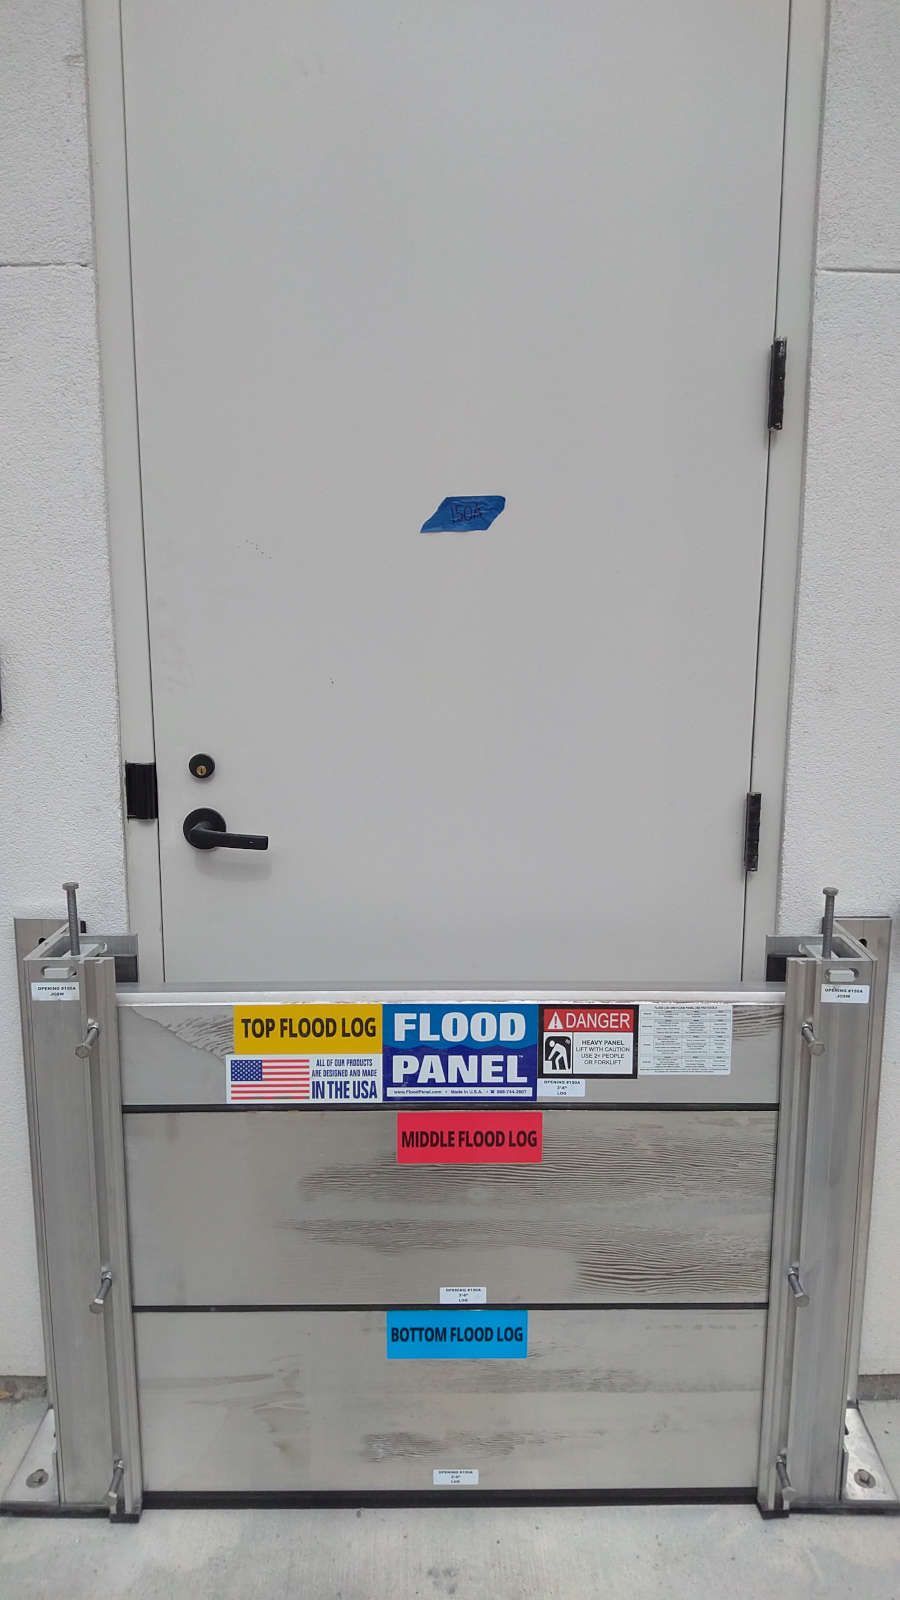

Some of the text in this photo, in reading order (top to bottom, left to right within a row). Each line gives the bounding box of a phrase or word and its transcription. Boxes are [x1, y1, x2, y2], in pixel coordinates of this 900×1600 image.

[241, 1017, 376, 1038] TOP FLOOD LOG
[394, 1012, 526, 1042] FLOOD
[566, 1012, 631, 1029] DANGER
[316, 1059, 372, 1067] ALL OF OUR PRODUCTS
[323, 1069, 348, 1077] DESIGNED
[350, 1069, 360, 1077] AND
[362, 1069, 377, 1077] MADE
[312, 1081, 377, 1099] IN THE USA
[401, 1130, 537, 1148] MIDDLE FLOOD LOG
[391, 1327, 523, 1342] BOTTOM FLOOD LOG
